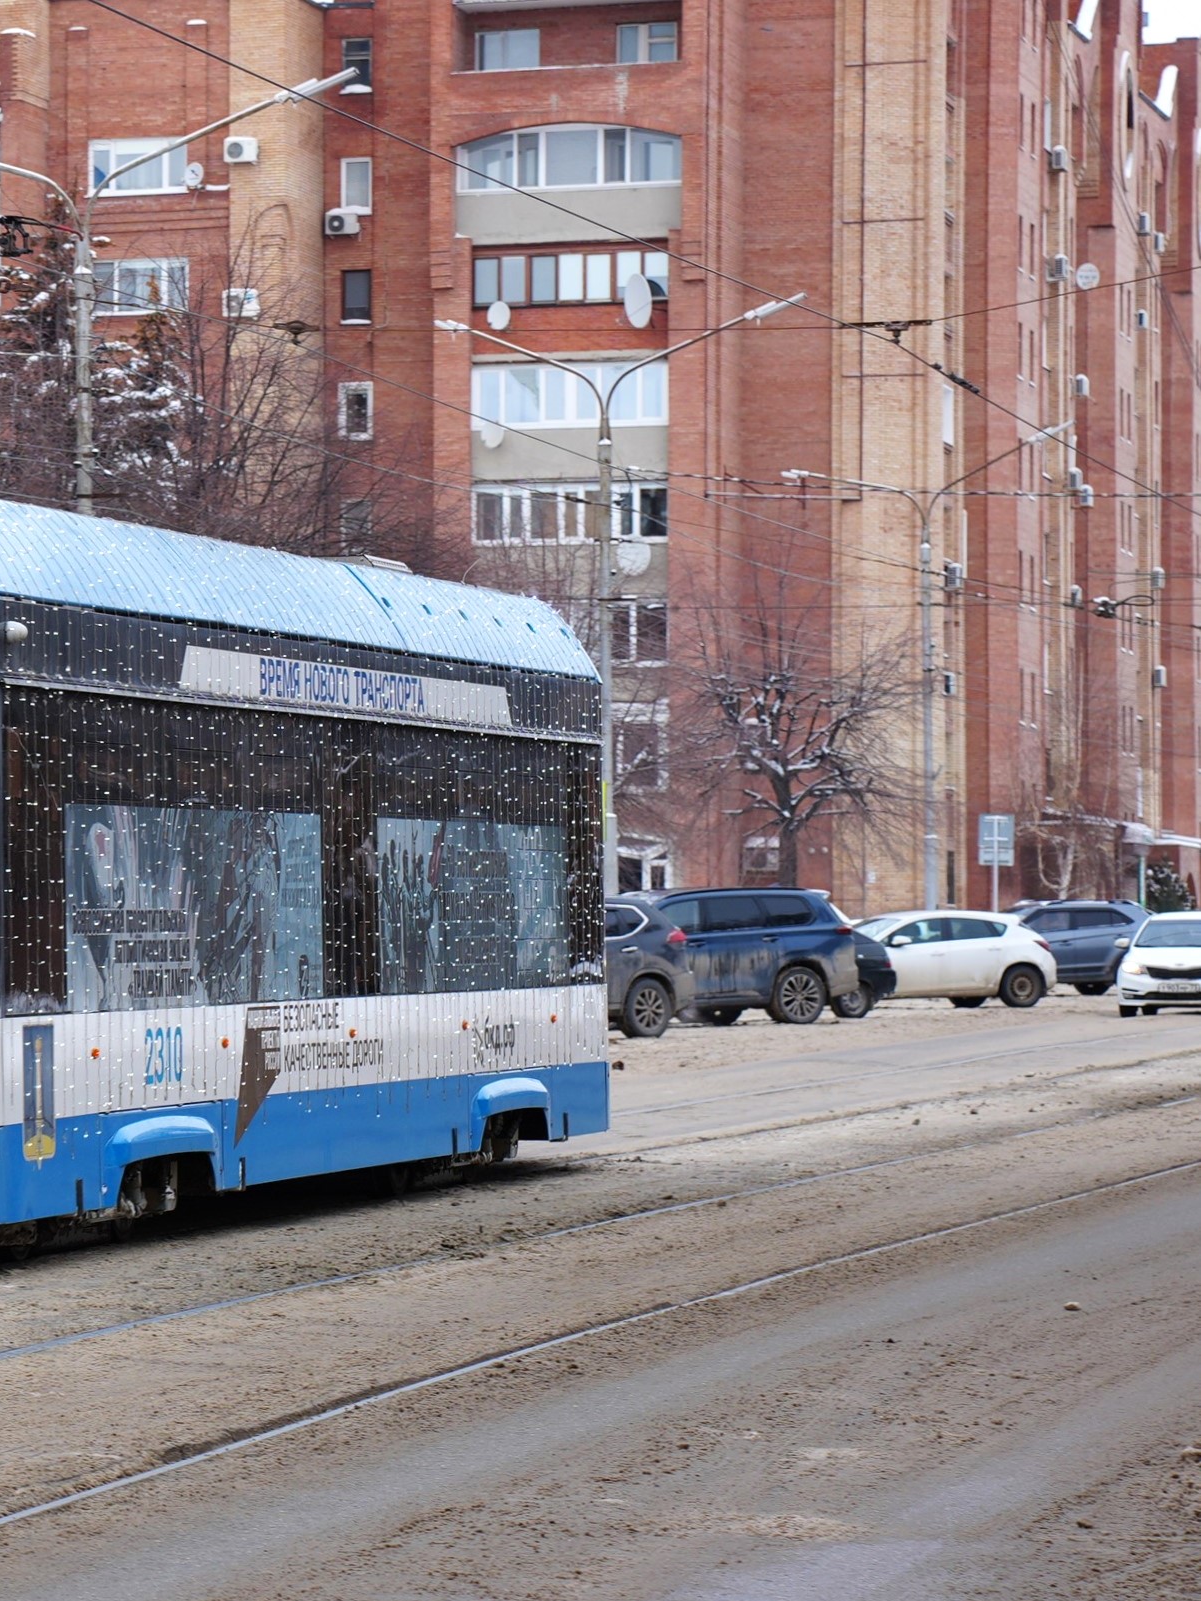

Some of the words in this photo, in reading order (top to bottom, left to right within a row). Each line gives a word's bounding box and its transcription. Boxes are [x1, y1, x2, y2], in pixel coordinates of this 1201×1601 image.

[260, 657, 299, 697] ВРЕМЯ
[304, 663, 349, 704] НОВОГО
[354, 670, 424, 712] ТРАНСПОРТА
[283, 1002, 340, 1032] БЕЗОПАСНЫЕ
[145, 1027, 183, 1085] 2310
[284, 1041, 350, 1073] КАЧЕСТВЕННЫЕ
[352, 1038, 384, 1074] ДОРОГИ
